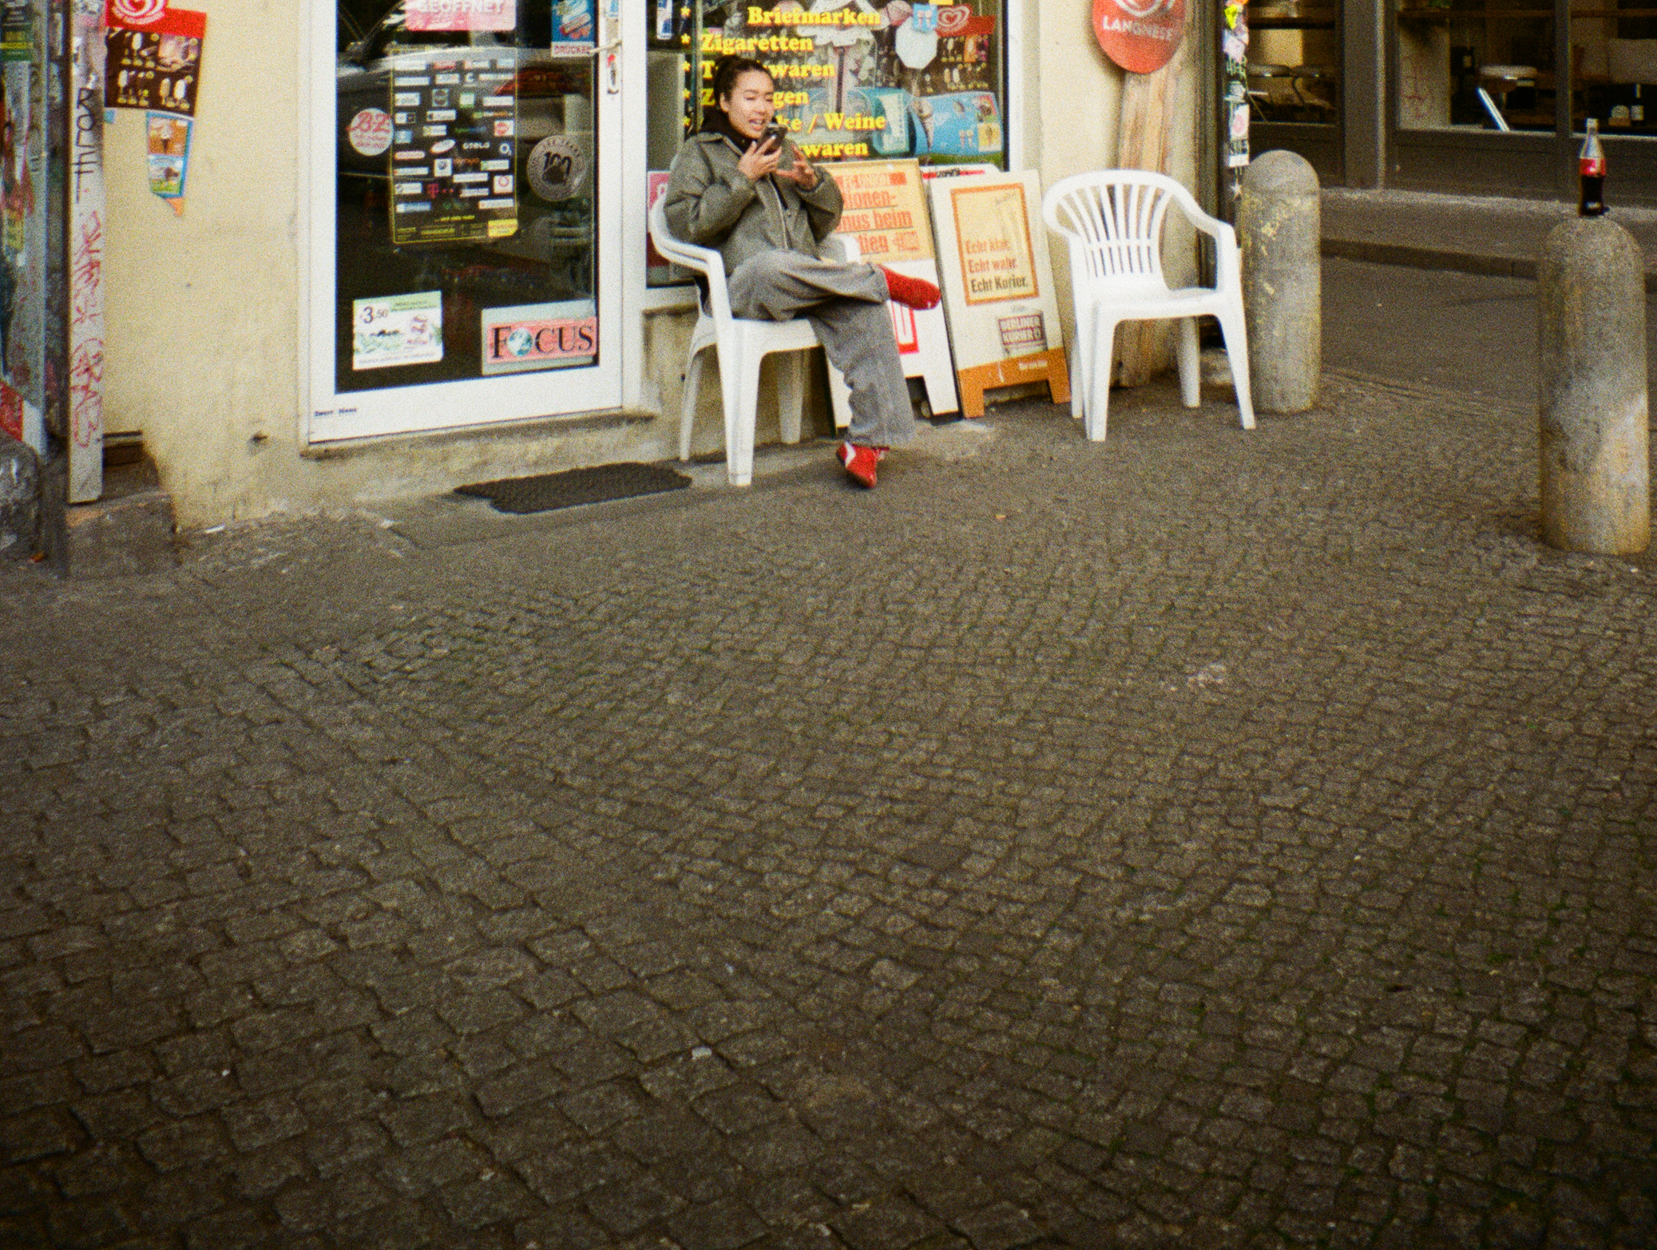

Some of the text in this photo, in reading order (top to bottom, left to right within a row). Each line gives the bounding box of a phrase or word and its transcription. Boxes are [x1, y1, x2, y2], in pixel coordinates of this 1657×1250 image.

[747, 5, 882, 27] Briefmarken
[701, 33, 815, 55] Zigaretten
[823, 111, 888, 131] Weine
[873, 208, 914, 230] beim
[968, 258, 990, 274] Echt
[970, 274, 1029, 293] Echt Kurier.
[491, 324, 594, 359] FOCUS
